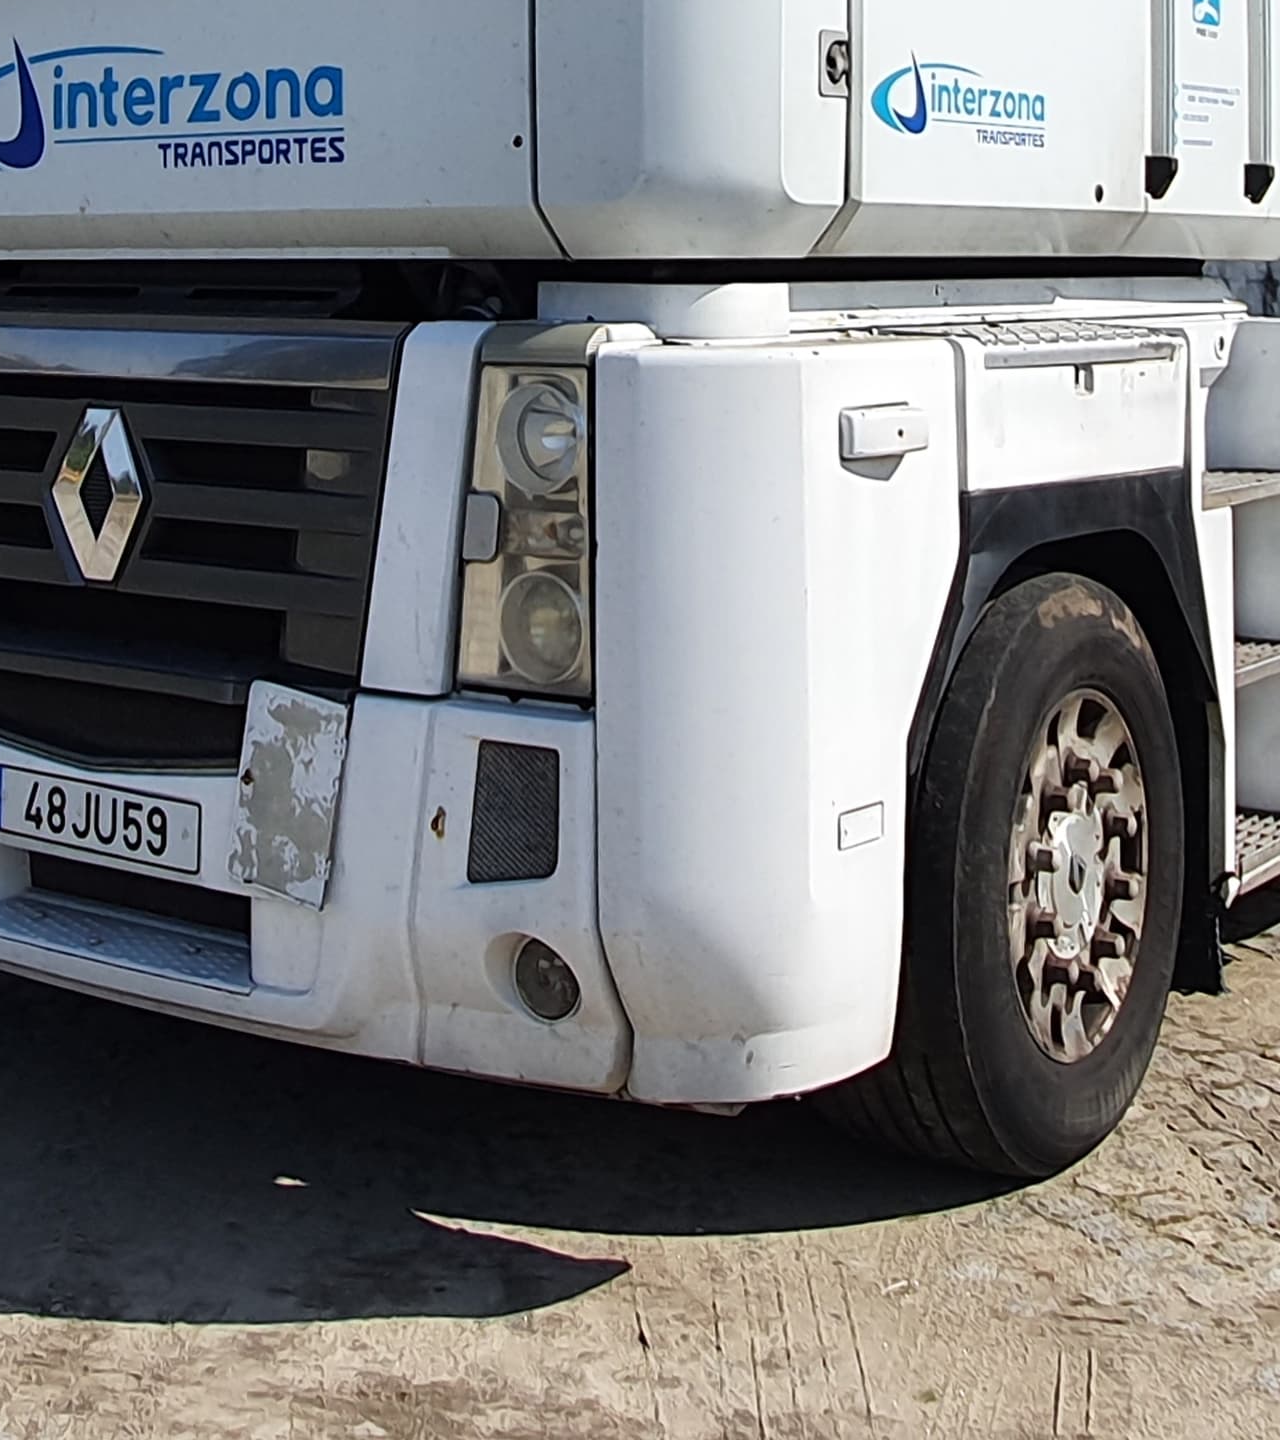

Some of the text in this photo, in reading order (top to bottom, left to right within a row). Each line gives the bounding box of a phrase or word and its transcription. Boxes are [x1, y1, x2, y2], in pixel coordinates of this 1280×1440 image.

[52, 64, 344, 131] interzona
[930, 71, 1046, 122] interzona
[157, 136, 346, 169] TRANSPORTES
[975, 128, 1046, 149] TRANSPORTES
[23, 780, 169, 858] 48JU59
